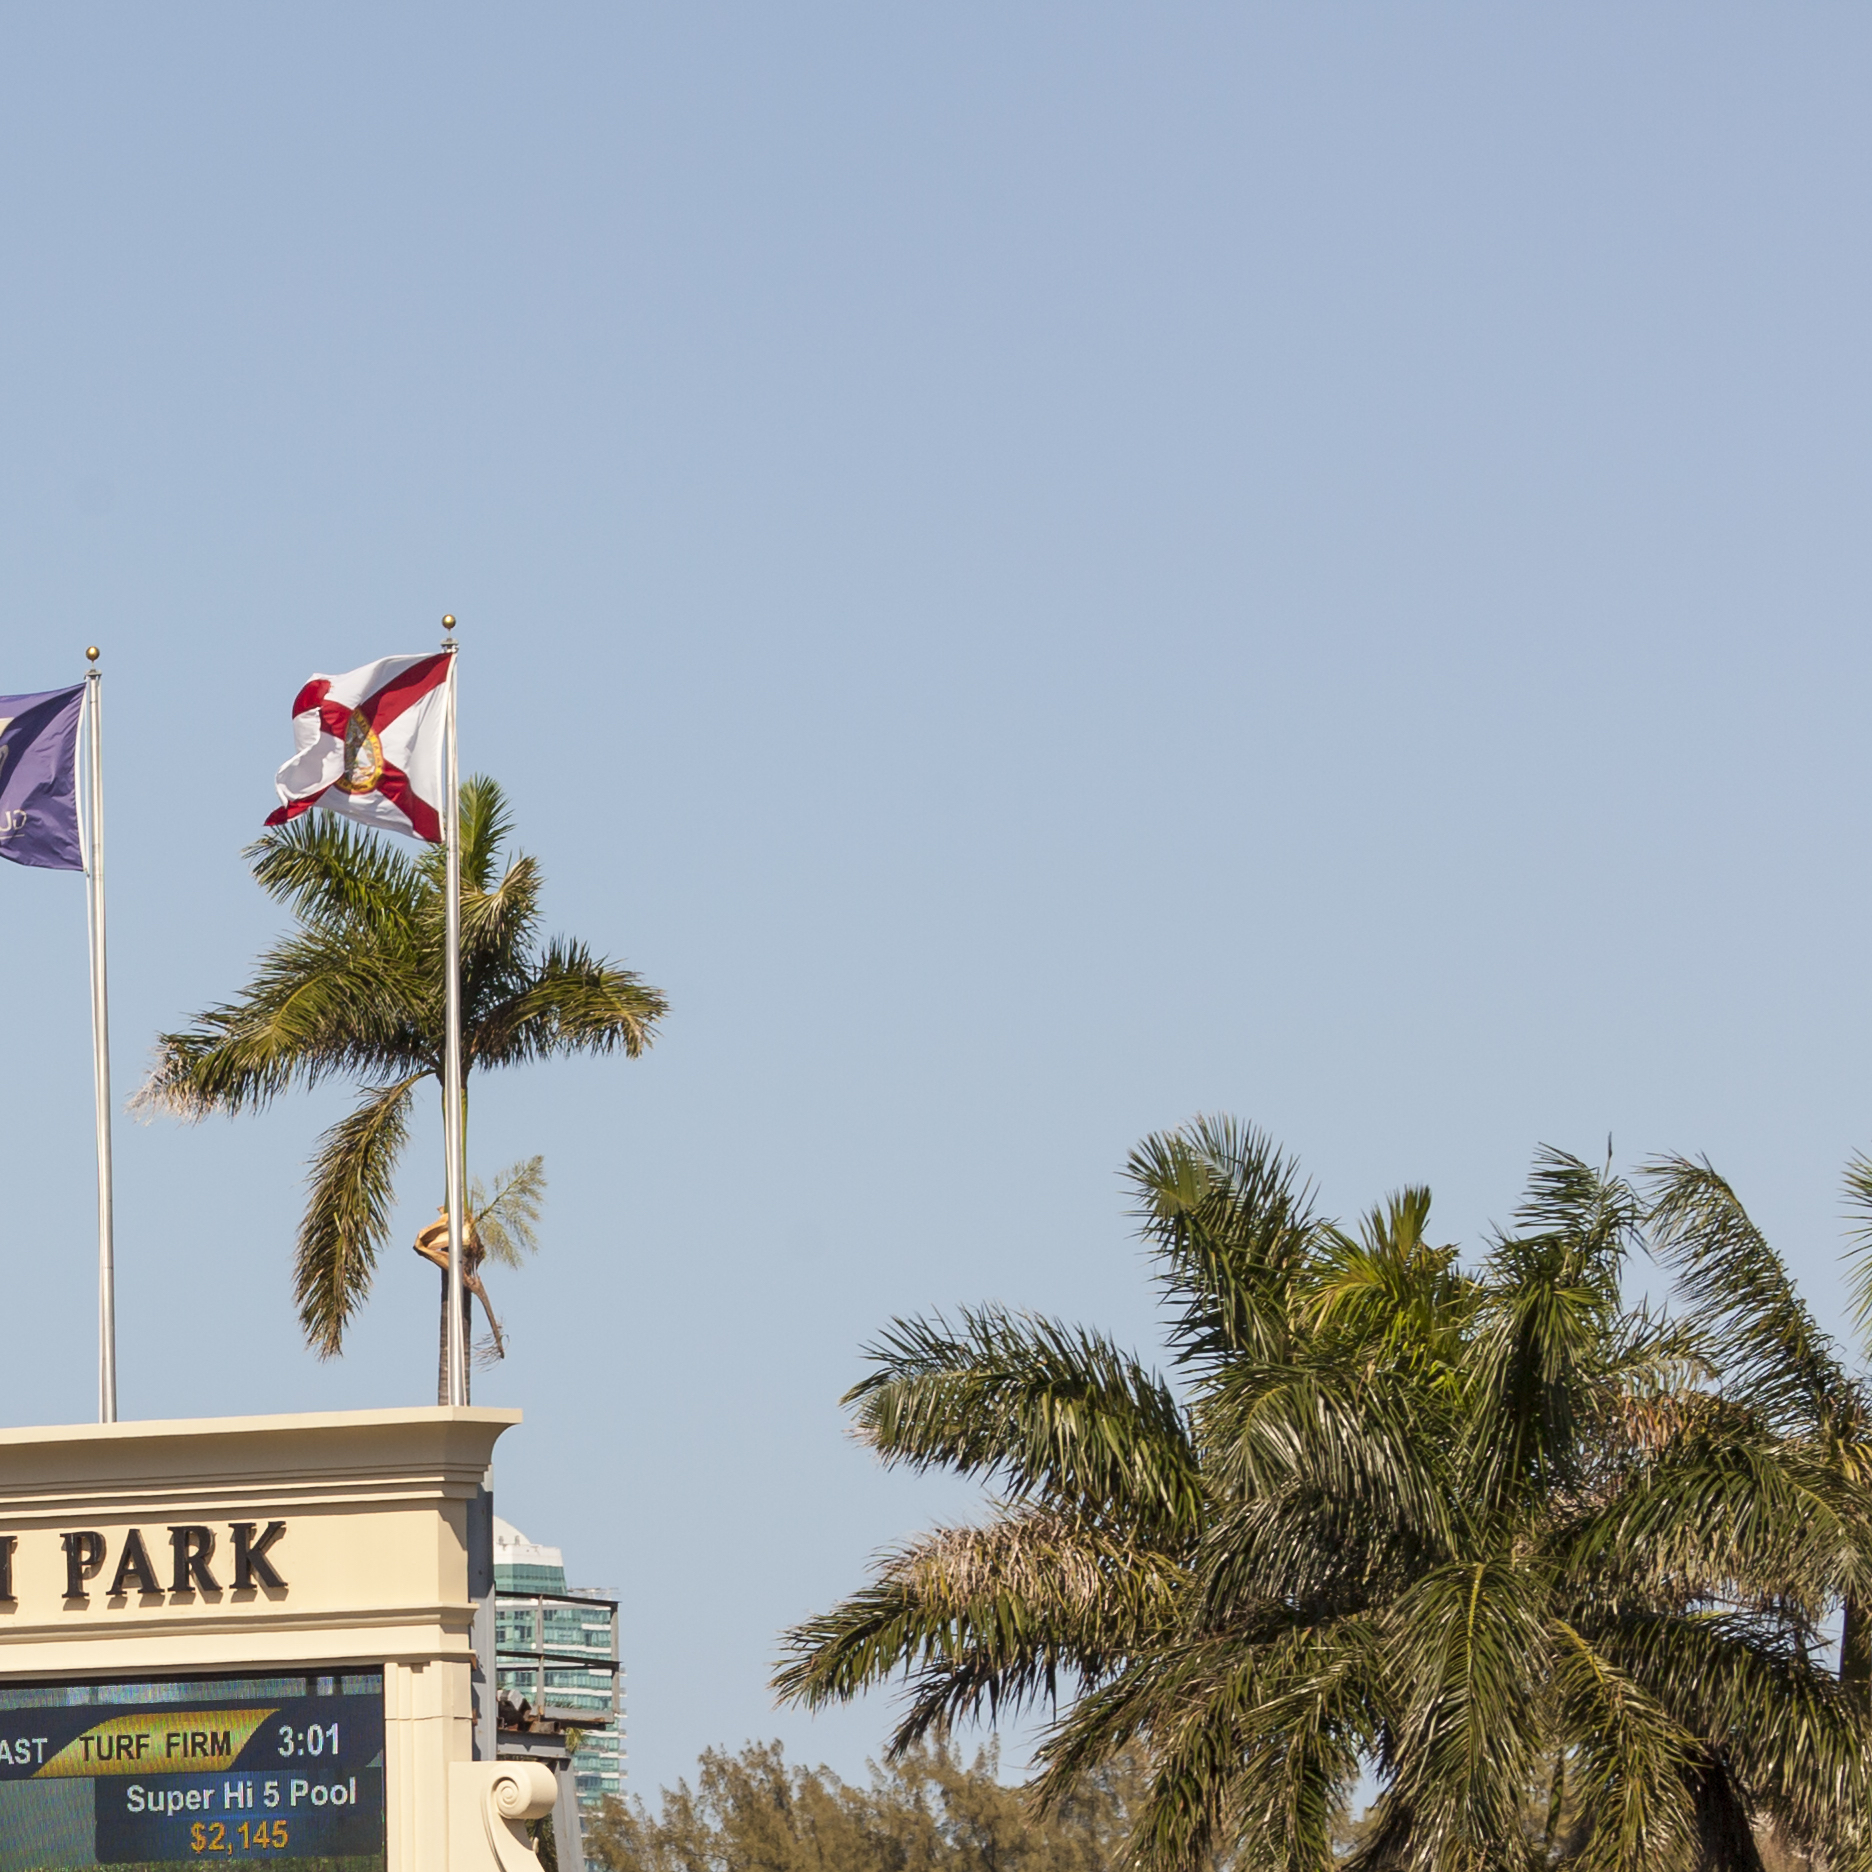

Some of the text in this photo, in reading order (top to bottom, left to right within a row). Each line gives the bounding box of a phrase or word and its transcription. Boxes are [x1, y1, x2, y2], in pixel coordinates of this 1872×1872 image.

[59, 1520, 292, 1600] PARK
[80, 1733, 150, 1762] TURF
[166, 1730, 232, 1759] FIRM
[278, 1722, 340, 1757] 3:01
[126, 1777, 357, 1816] Super Hi 5 Pool
[190, 1819, 288, 1856] $2,145
